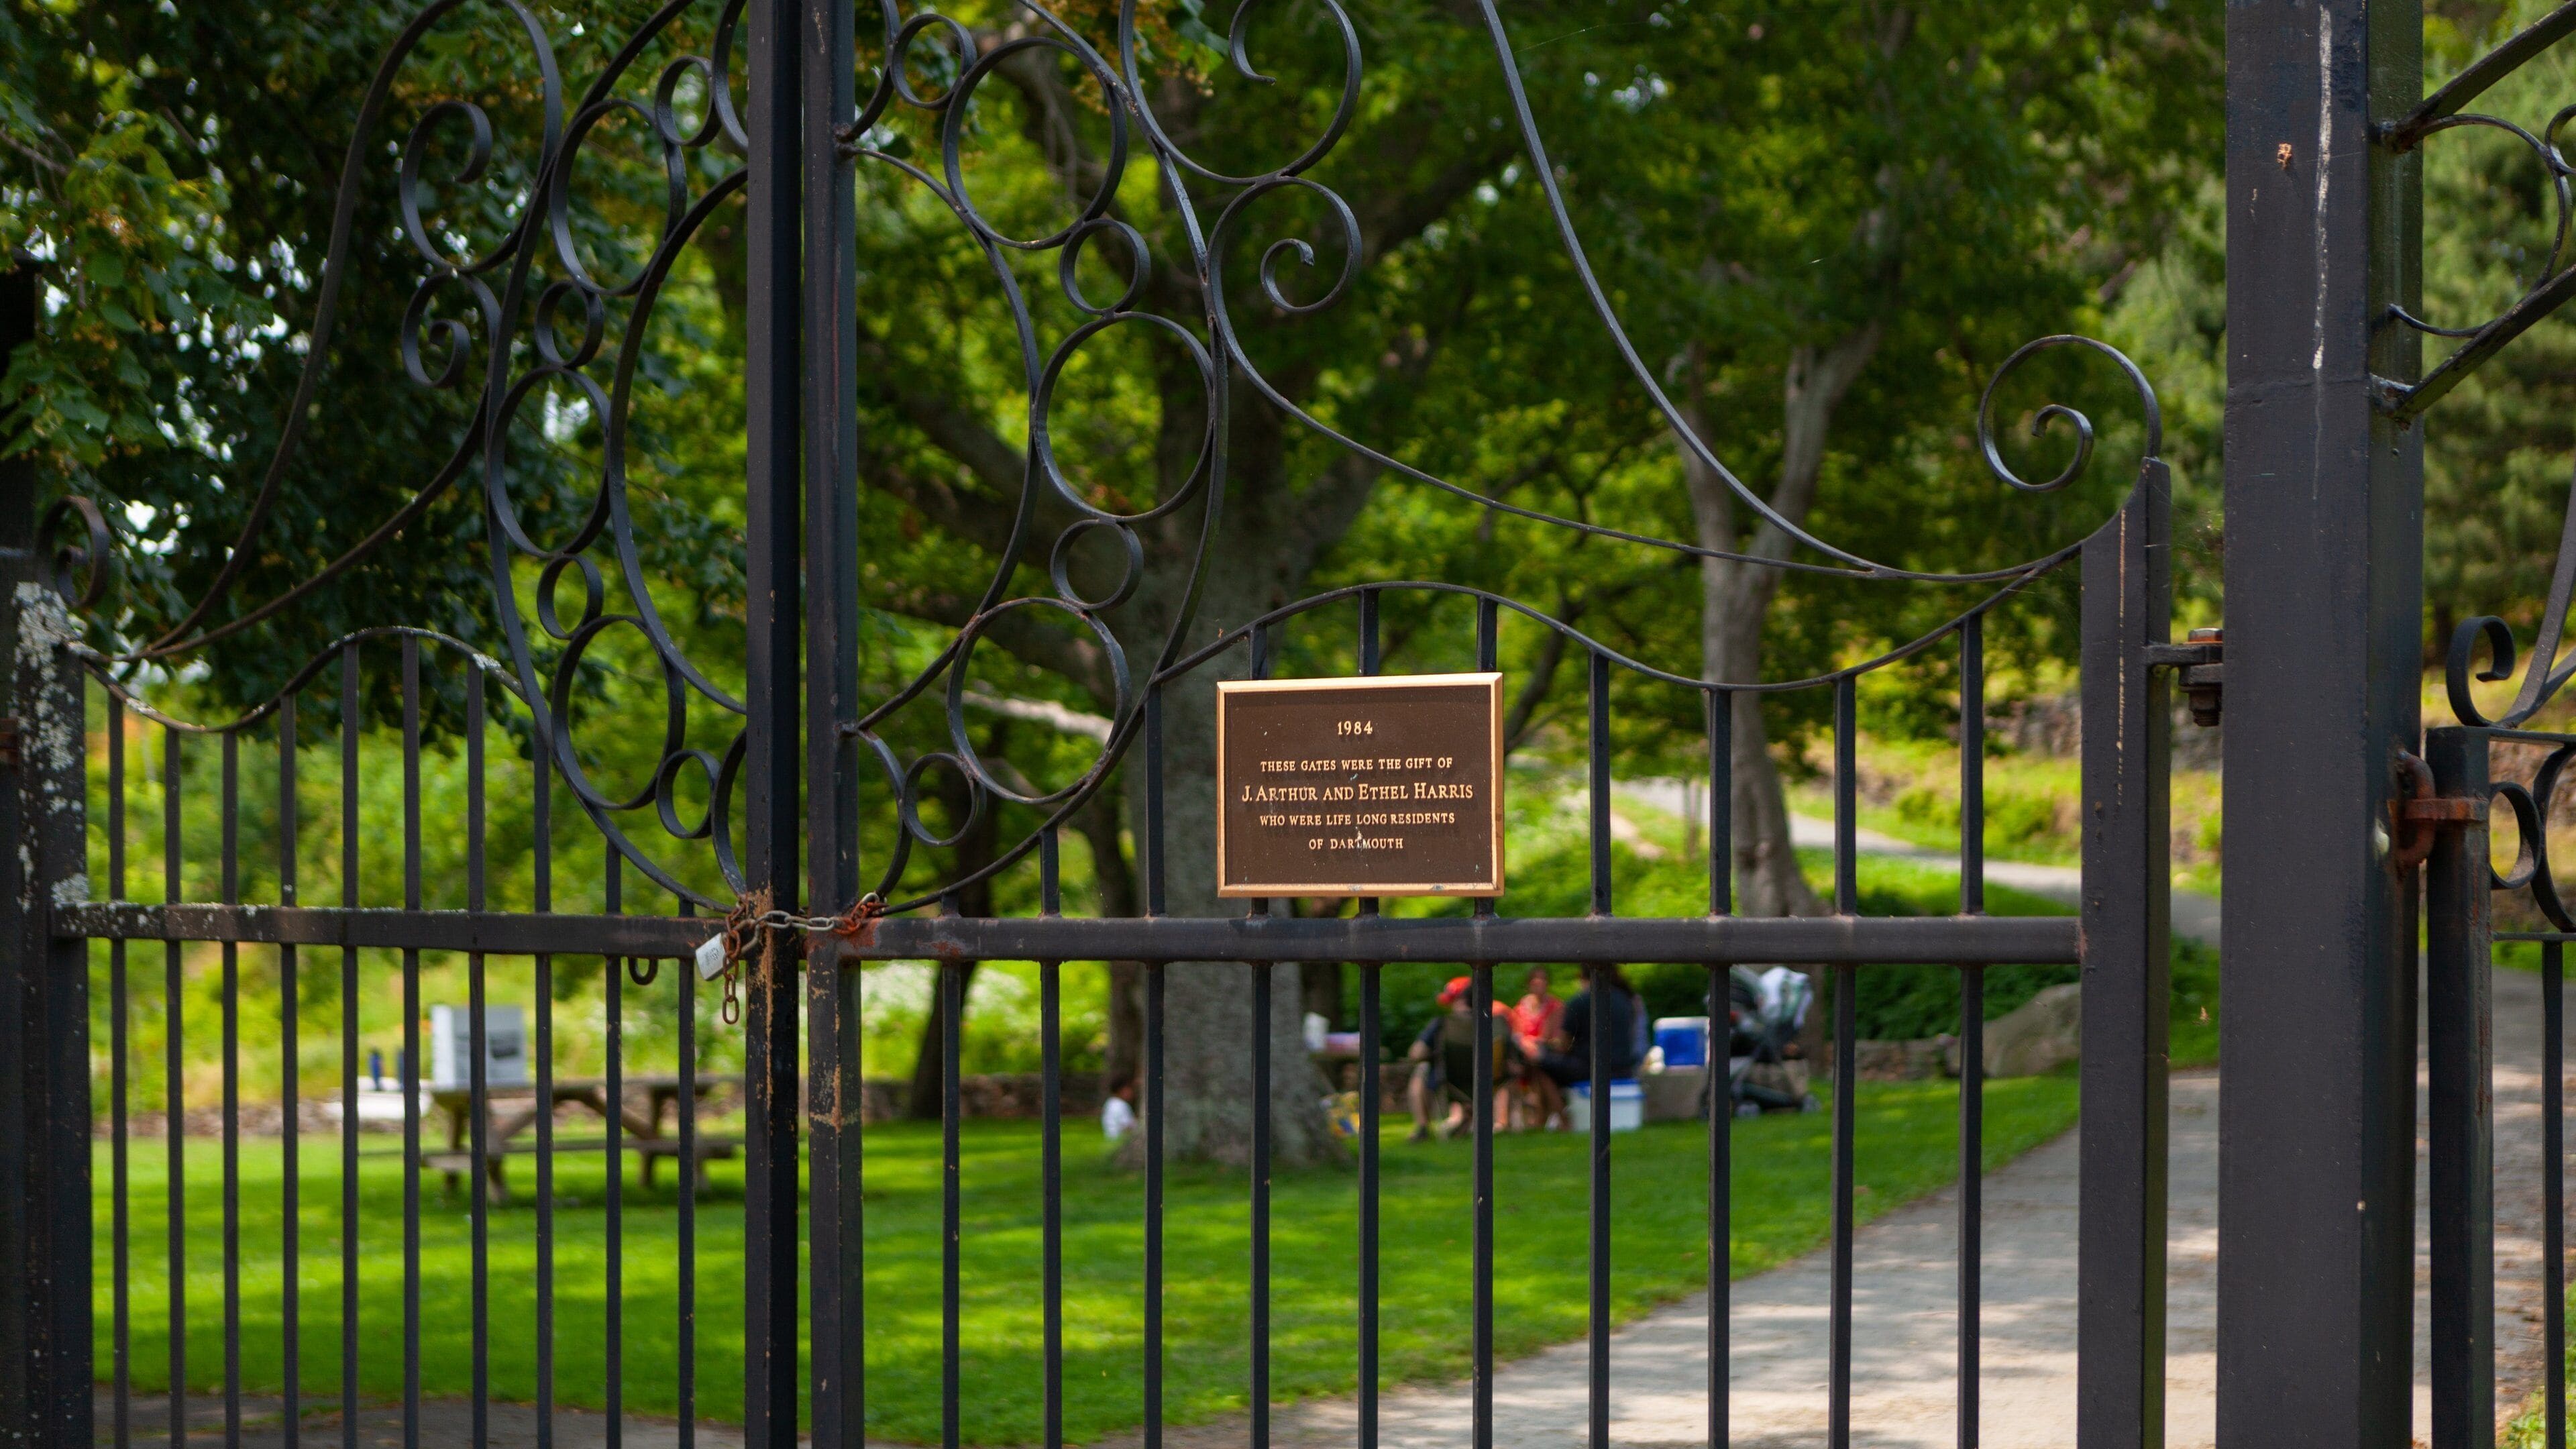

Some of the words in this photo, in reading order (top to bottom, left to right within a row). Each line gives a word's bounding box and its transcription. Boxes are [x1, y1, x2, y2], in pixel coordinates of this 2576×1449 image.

[1338, 720, 1373, 735] 1984
[1260, 761, 1296, 771] THESE
[1301, 760, 1336, 771] GATES
[1341, 759, 1373, 770] WERE
[1379, 759, 1401, 769] THE
[1405, 758, 1432, 769] GIFT
[1438, 757, 1453, 768] OF
[1242, 786, 1252, 802] J.
[1256, 785, 1318, 802] ARTHUR
[1323, 787, 1354, 800] AND
[1358, 784, 1409, 800] ETHEL
[1414, 782, 1473, 799] HARRIS
[1260, 815, 1285, 826] WHO
[1289, 815, 1322, 825] WERE
[1326, 814, 1352, 825] LIFE
[1356, 814, 1387, 824] LONG
[1391, 812, 1455, 824] RESIDENTS
[1309, 839, 1324, 850] OF
[1330, 838, 1403, 849] DARTMOUTH
